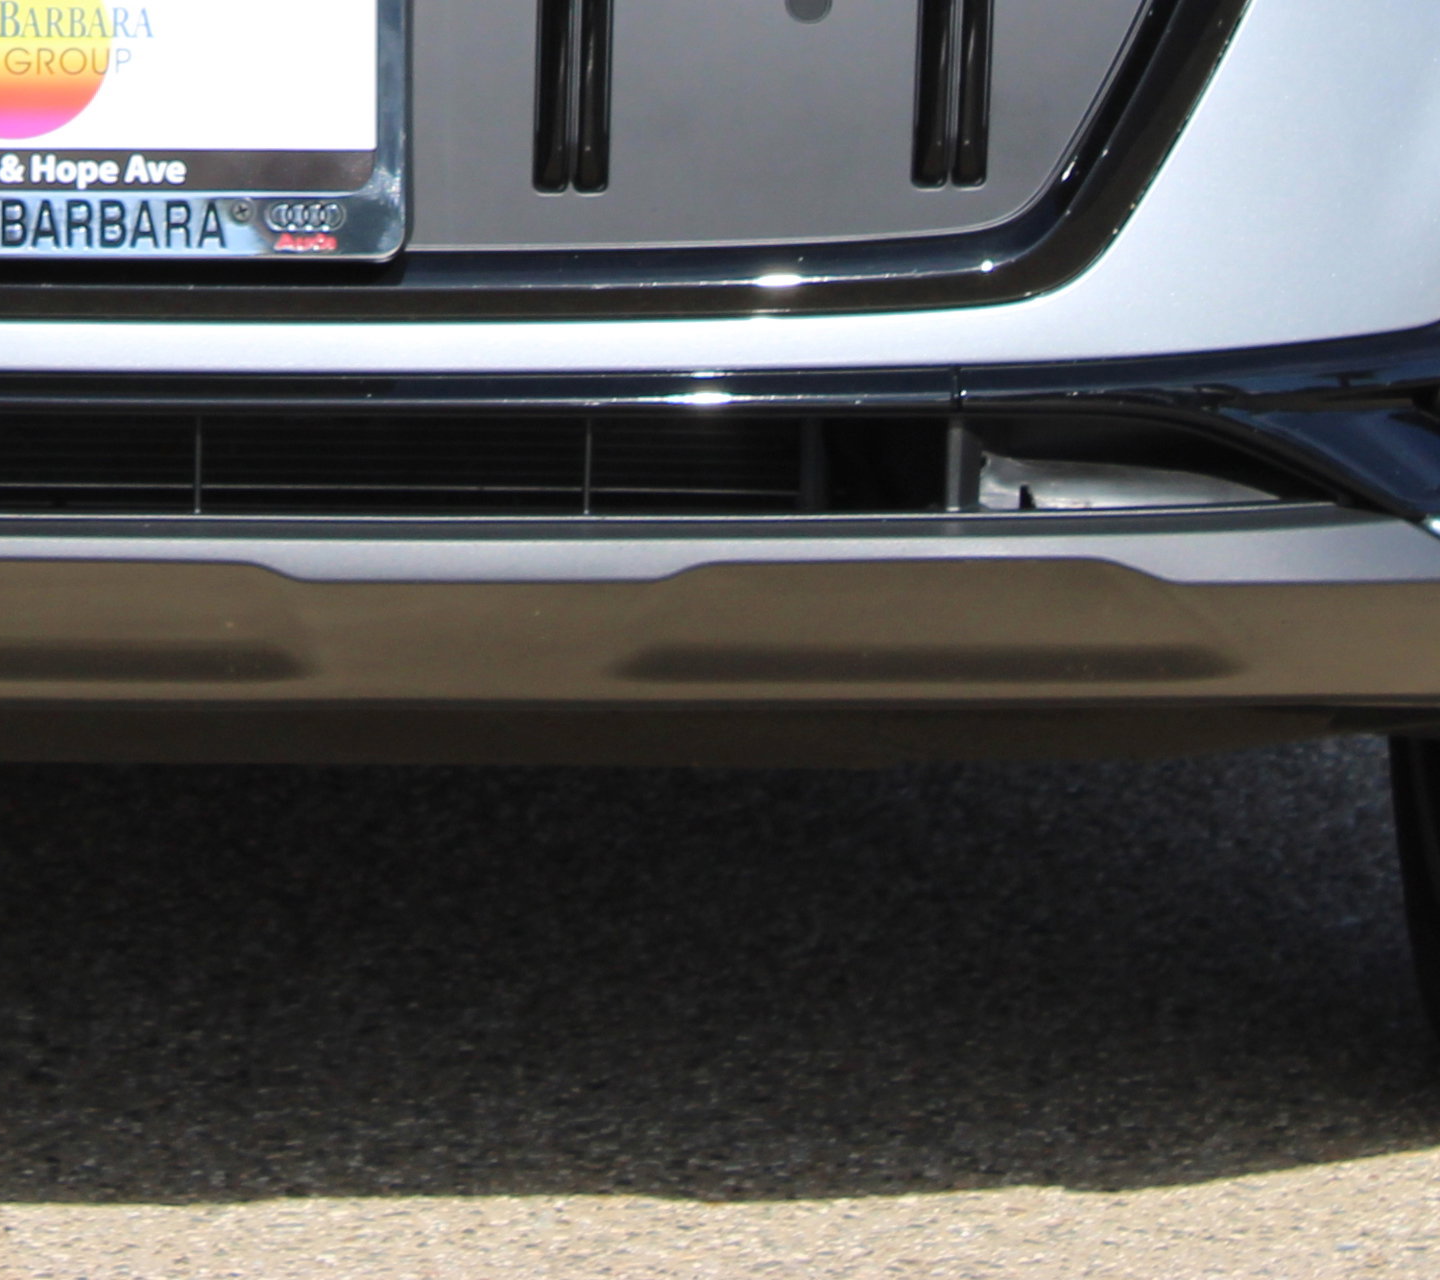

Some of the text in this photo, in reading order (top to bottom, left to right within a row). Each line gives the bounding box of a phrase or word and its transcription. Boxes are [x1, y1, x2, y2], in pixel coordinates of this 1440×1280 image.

[4, 46, 132, 75] GROUP
[30, 154, 119, 190] Hope
[124, 155, 186, 184] Ave
[0, 199, 227, 249] BARBARA
